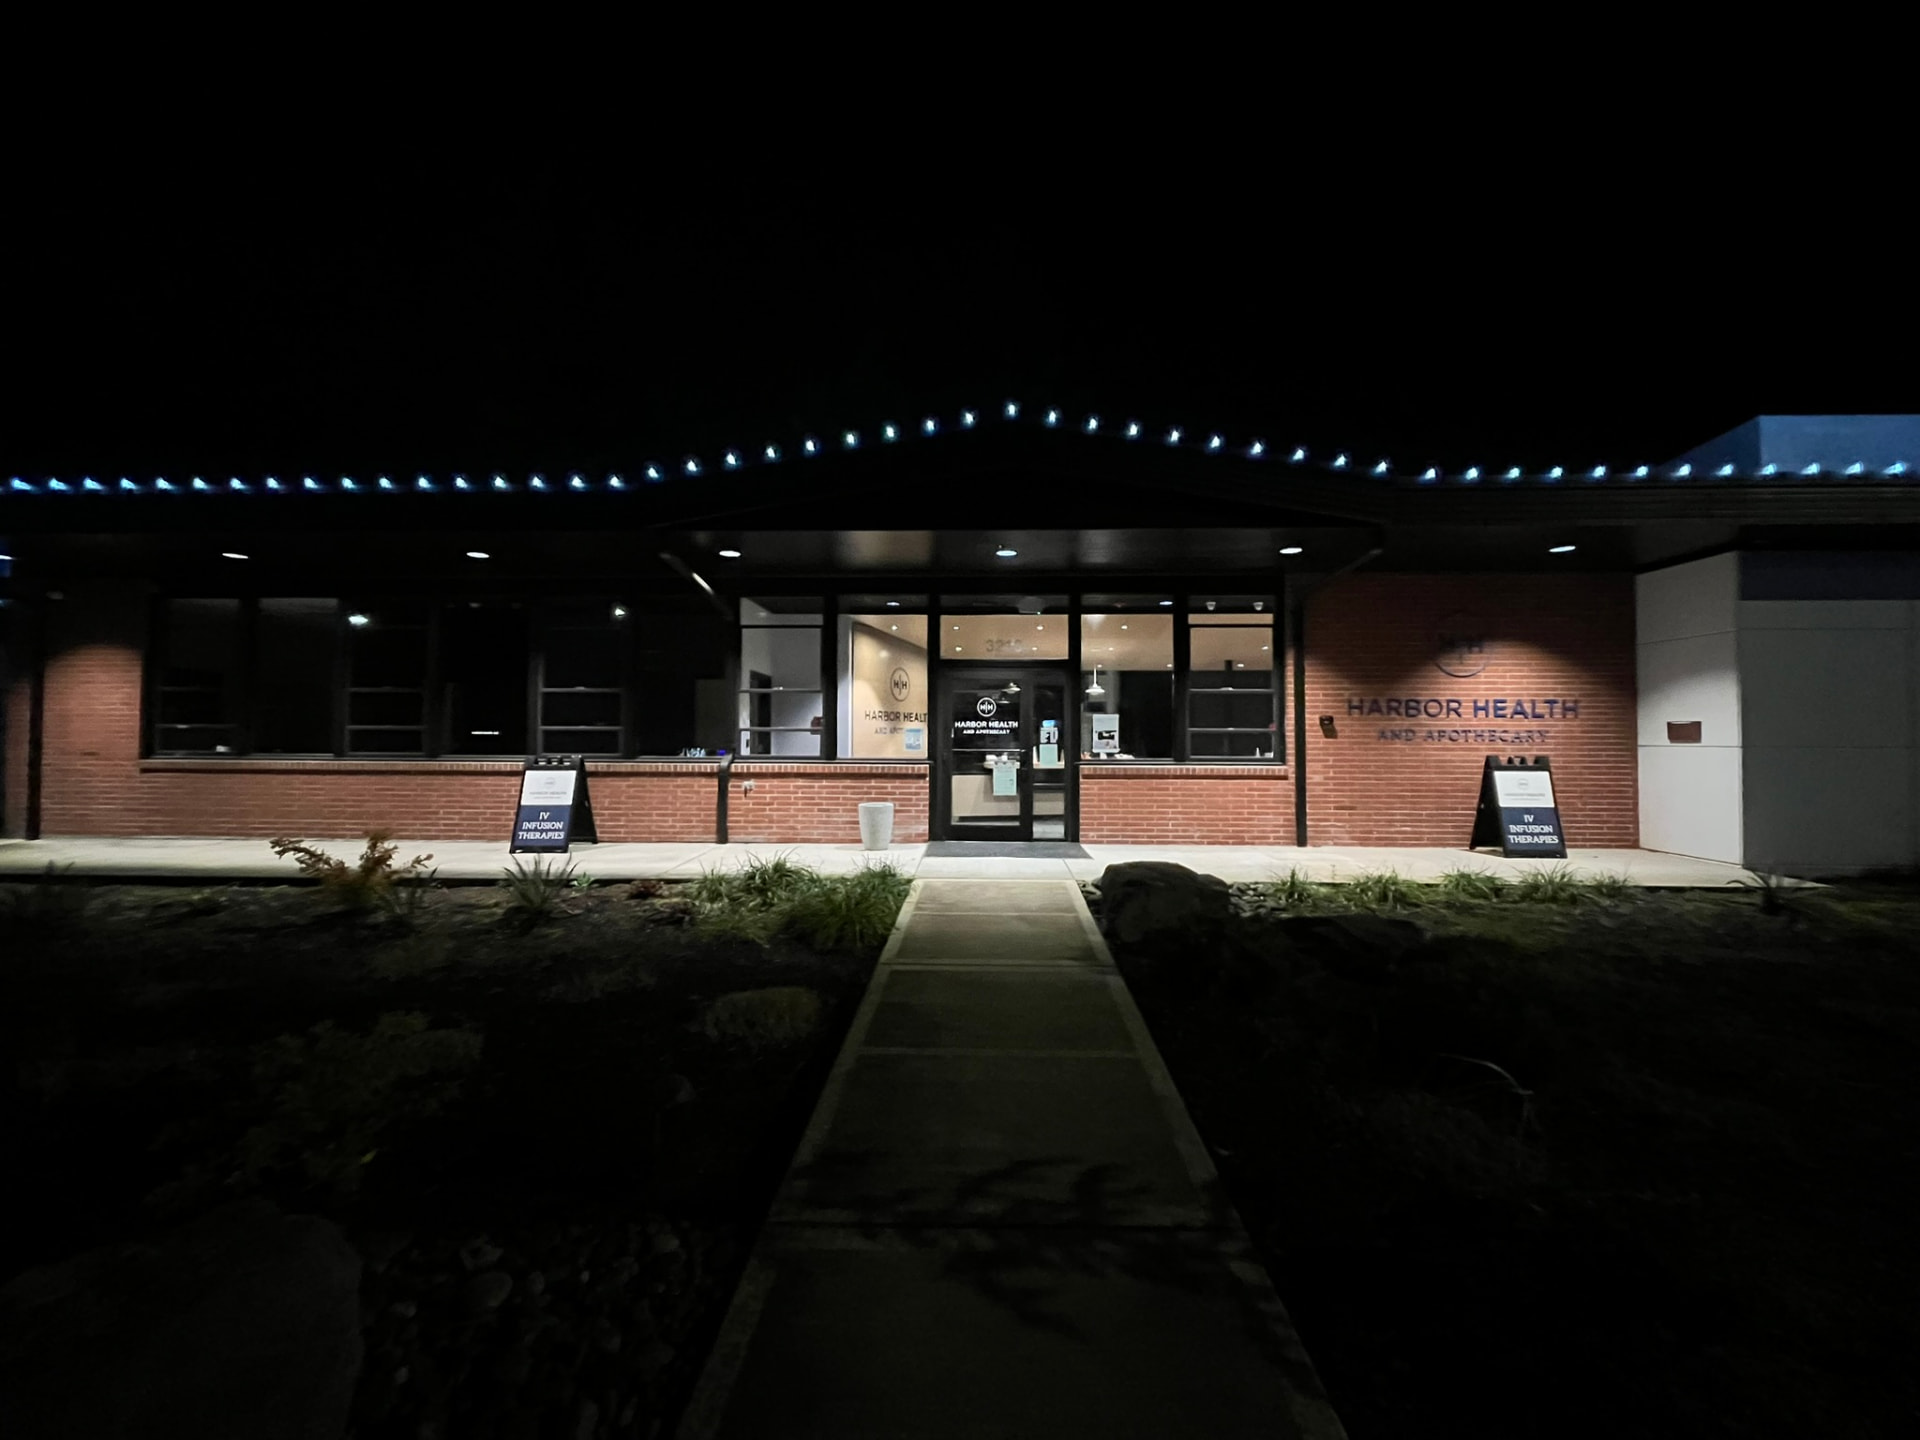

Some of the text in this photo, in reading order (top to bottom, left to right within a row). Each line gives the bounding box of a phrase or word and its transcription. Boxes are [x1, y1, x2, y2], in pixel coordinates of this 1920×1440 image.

[1348, 699, 1580, 719] HARBOR HEALTH
[865, 711, 928, 722] HARBOR HEALT
[1378, 729, 1549, 743] AND APOTHECARY
[539, 812, 550, 820] IV
[1523, 814, 1535, 823] IV
[522, 821, 564, 830] INFUSION
[1509, 824, 1554, 833] INFUSION
[518, 831, 565, 840] THERAPIES
[1508, 835, 1559, 844] THERAPIES
